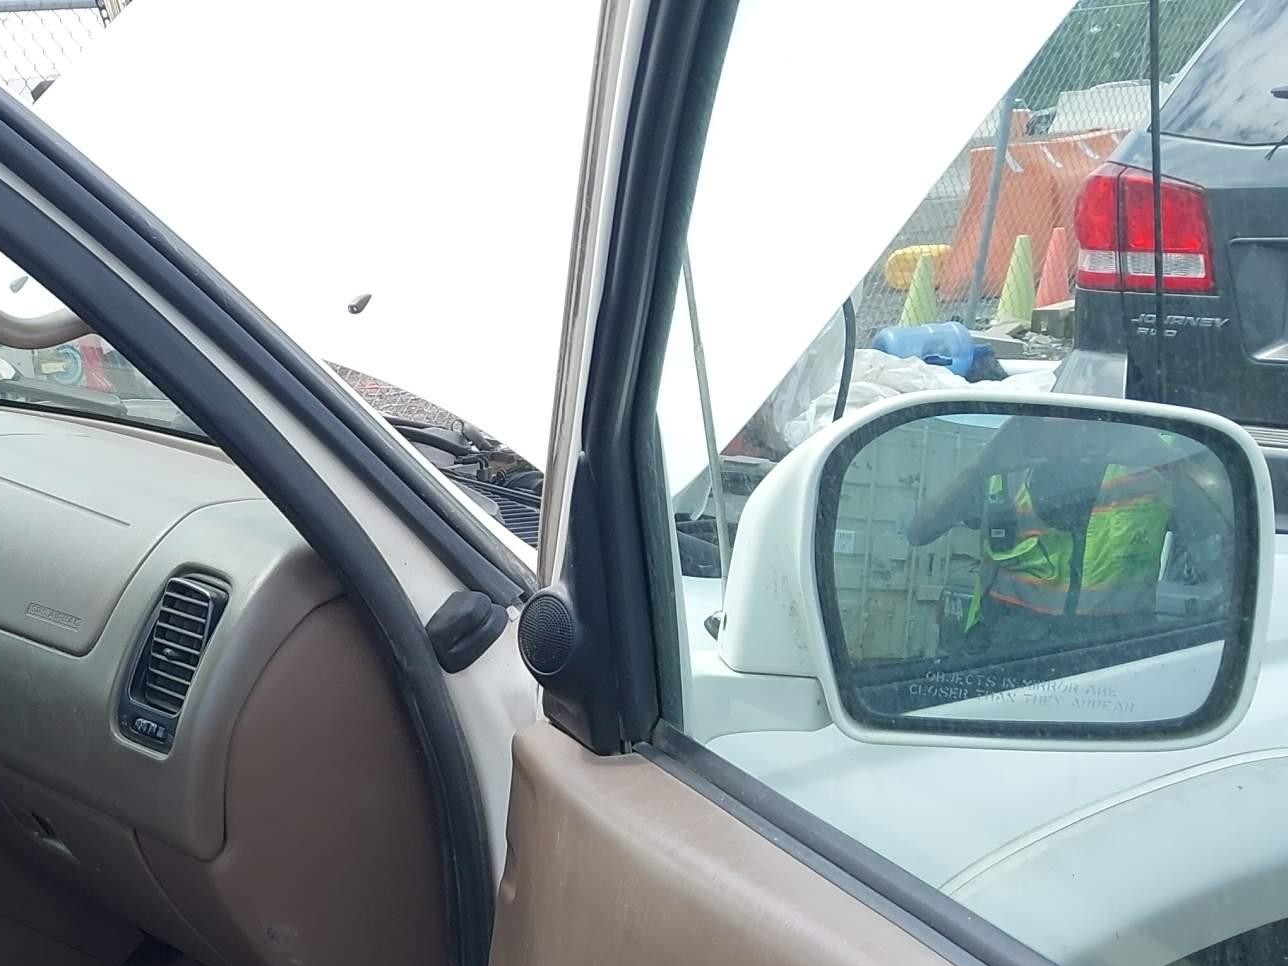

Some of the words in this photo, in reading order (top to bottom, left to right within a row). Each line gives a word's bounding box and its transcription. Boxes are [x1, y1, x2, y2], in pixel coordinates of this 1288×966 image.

[909, 684, 970, 700] CLOSER
[975, 688, 1017, 703] THAN
[925, 670, 996, 689] OBJECTS
[1002, 677, 1016, 689] IN
[1023, 679, 1079, 694] MIRROR
[1086, 684, 1117, 698] ARE
